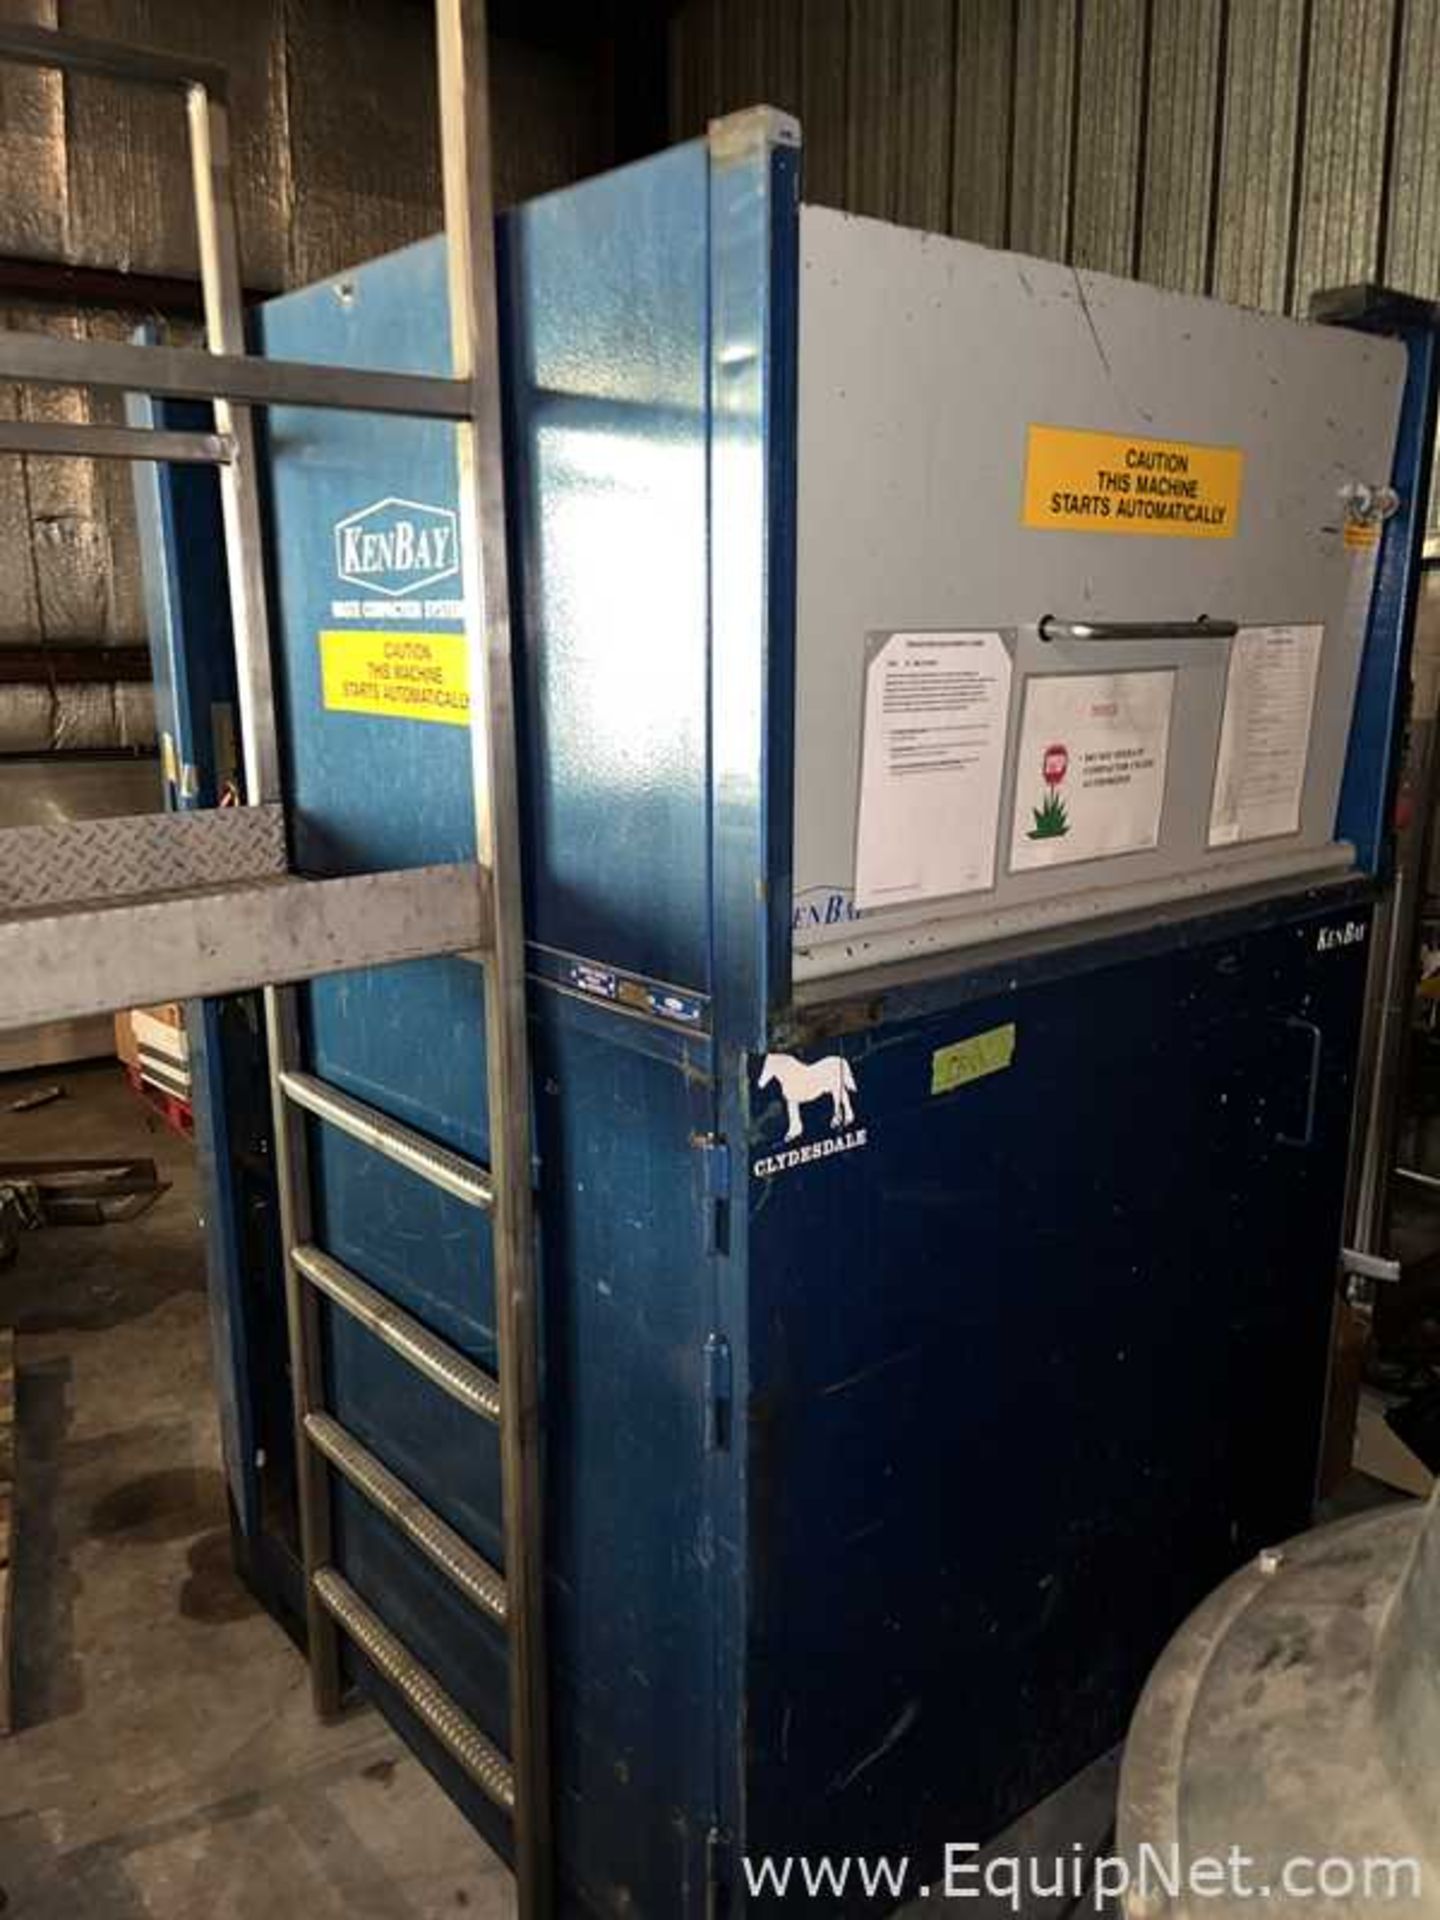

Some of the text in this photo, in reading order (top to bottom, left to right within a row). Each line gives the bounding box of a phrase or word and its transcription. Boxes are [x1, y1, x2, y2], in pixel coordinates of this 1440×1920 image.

[1125, 448, 1188, 472] CAUTION
[1098, 471, 1200, 498] THIS MACHINE
[1051, 493, 1227, 524] STARTS AUTOMATICALLY
[383, 642, 432, 661] CAUTION
[753, 1128, 868, 1178] CLYDESDALE
